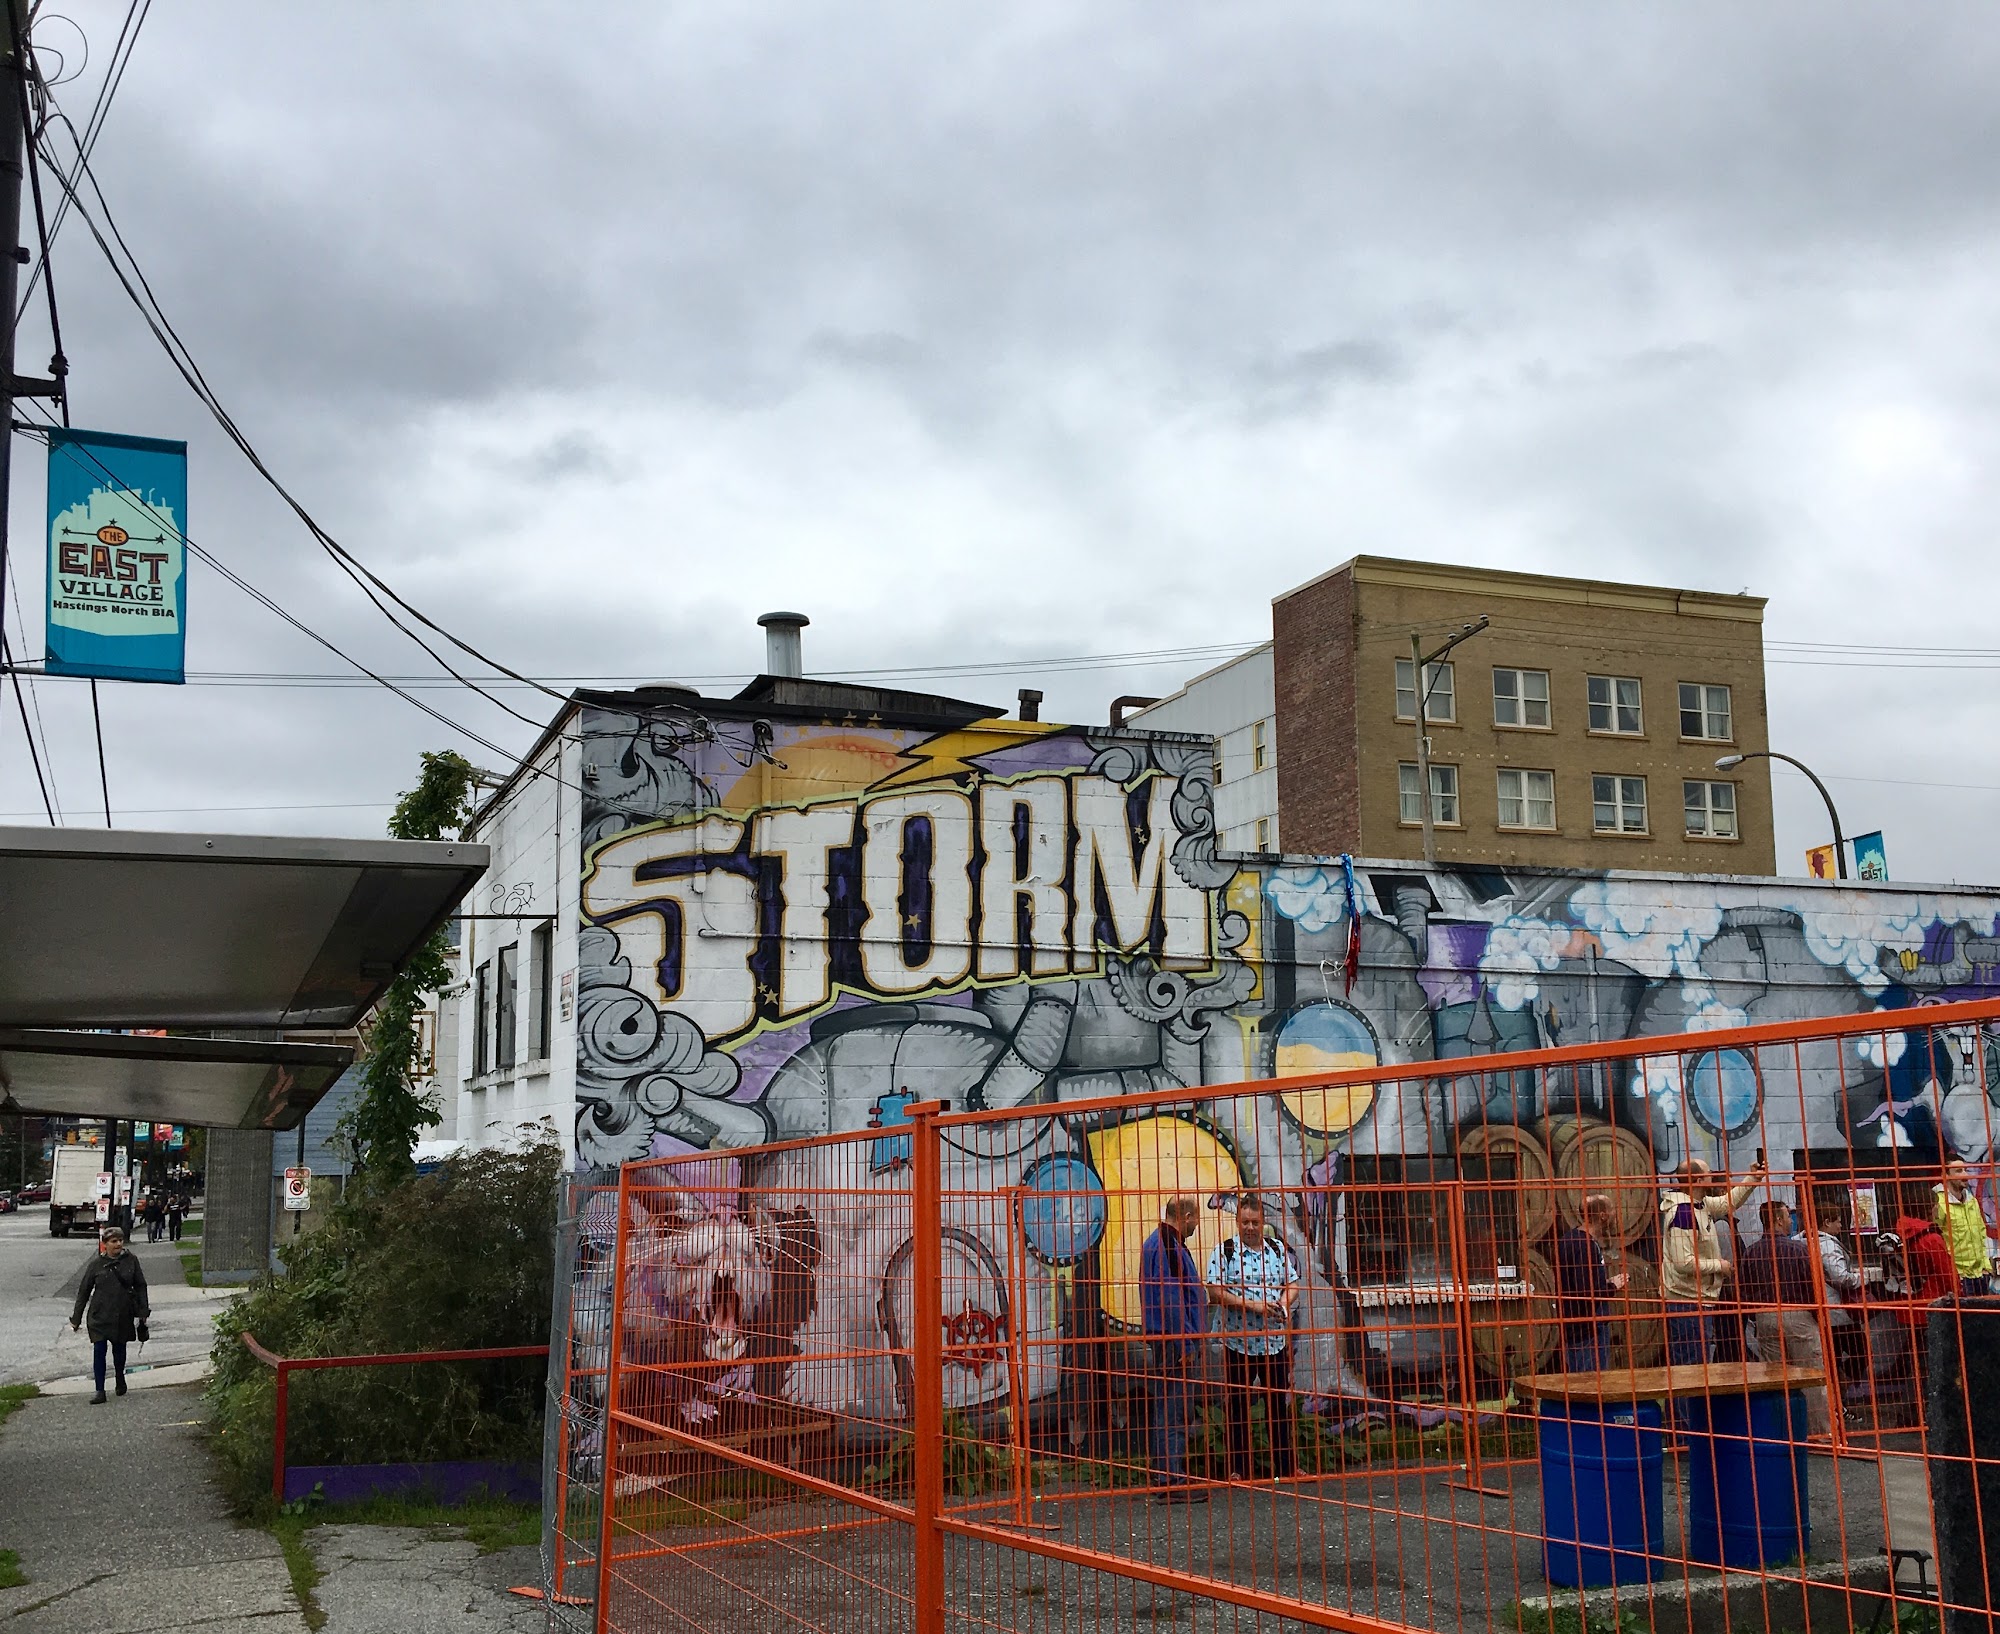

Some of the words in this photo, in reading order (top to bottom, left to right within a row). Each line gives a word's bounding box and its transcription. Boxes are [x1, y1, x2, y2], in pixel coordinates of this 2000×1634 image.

[103, 530, 123, 542] THE
[59, 542, 169, 585] EAST
[59, 579, 163, 601] VILLAGE
[53, 600, 108, 614] Hastings
[112, 605, 149, 617] North
[152, 608, 175, 618] BIA
[1861, 868, 1883, 881] EAST
[583, 774, 1214, 1045] STORM
